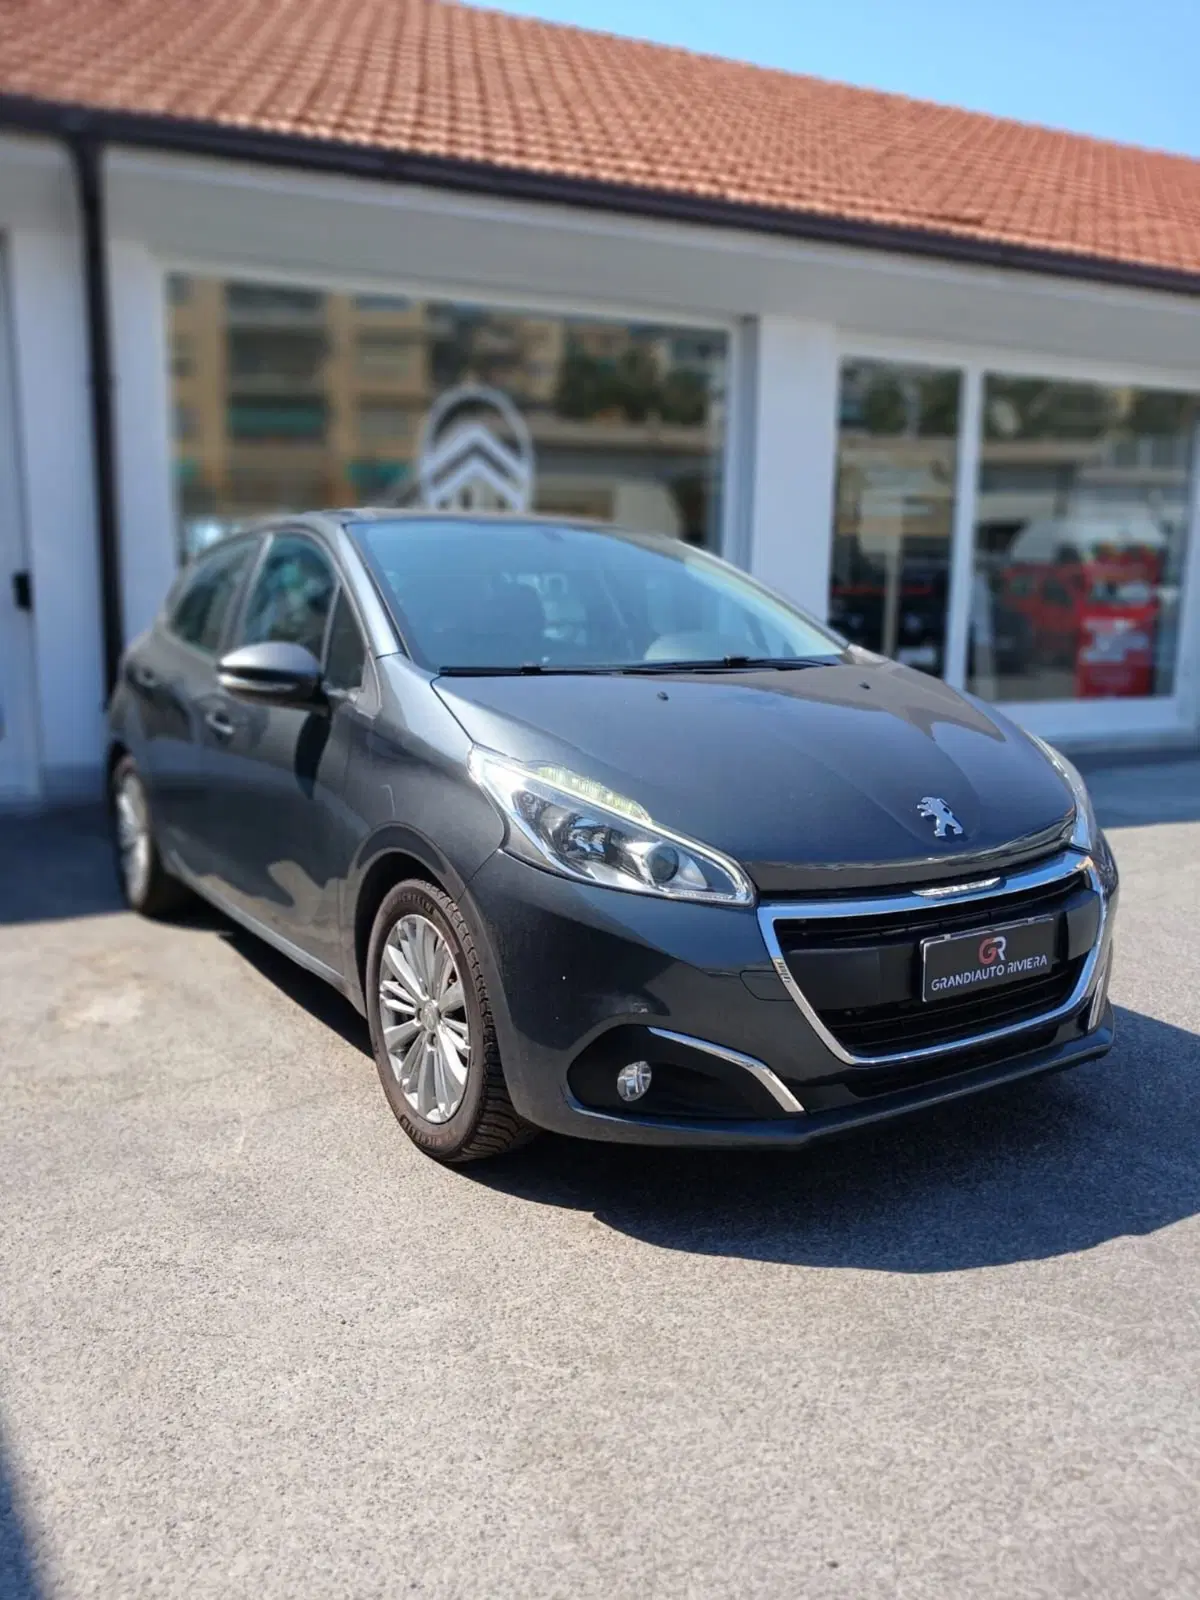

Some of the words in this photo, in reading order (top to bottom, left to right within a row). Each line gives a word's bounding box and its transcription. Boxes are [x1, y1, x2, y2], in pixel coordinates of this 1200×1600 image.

[979, 936, 1006, 964] GR
[931, 964, 1005, 991] GRANDIAUTO
[1007, 954, 1048, 974] RIVIERA
